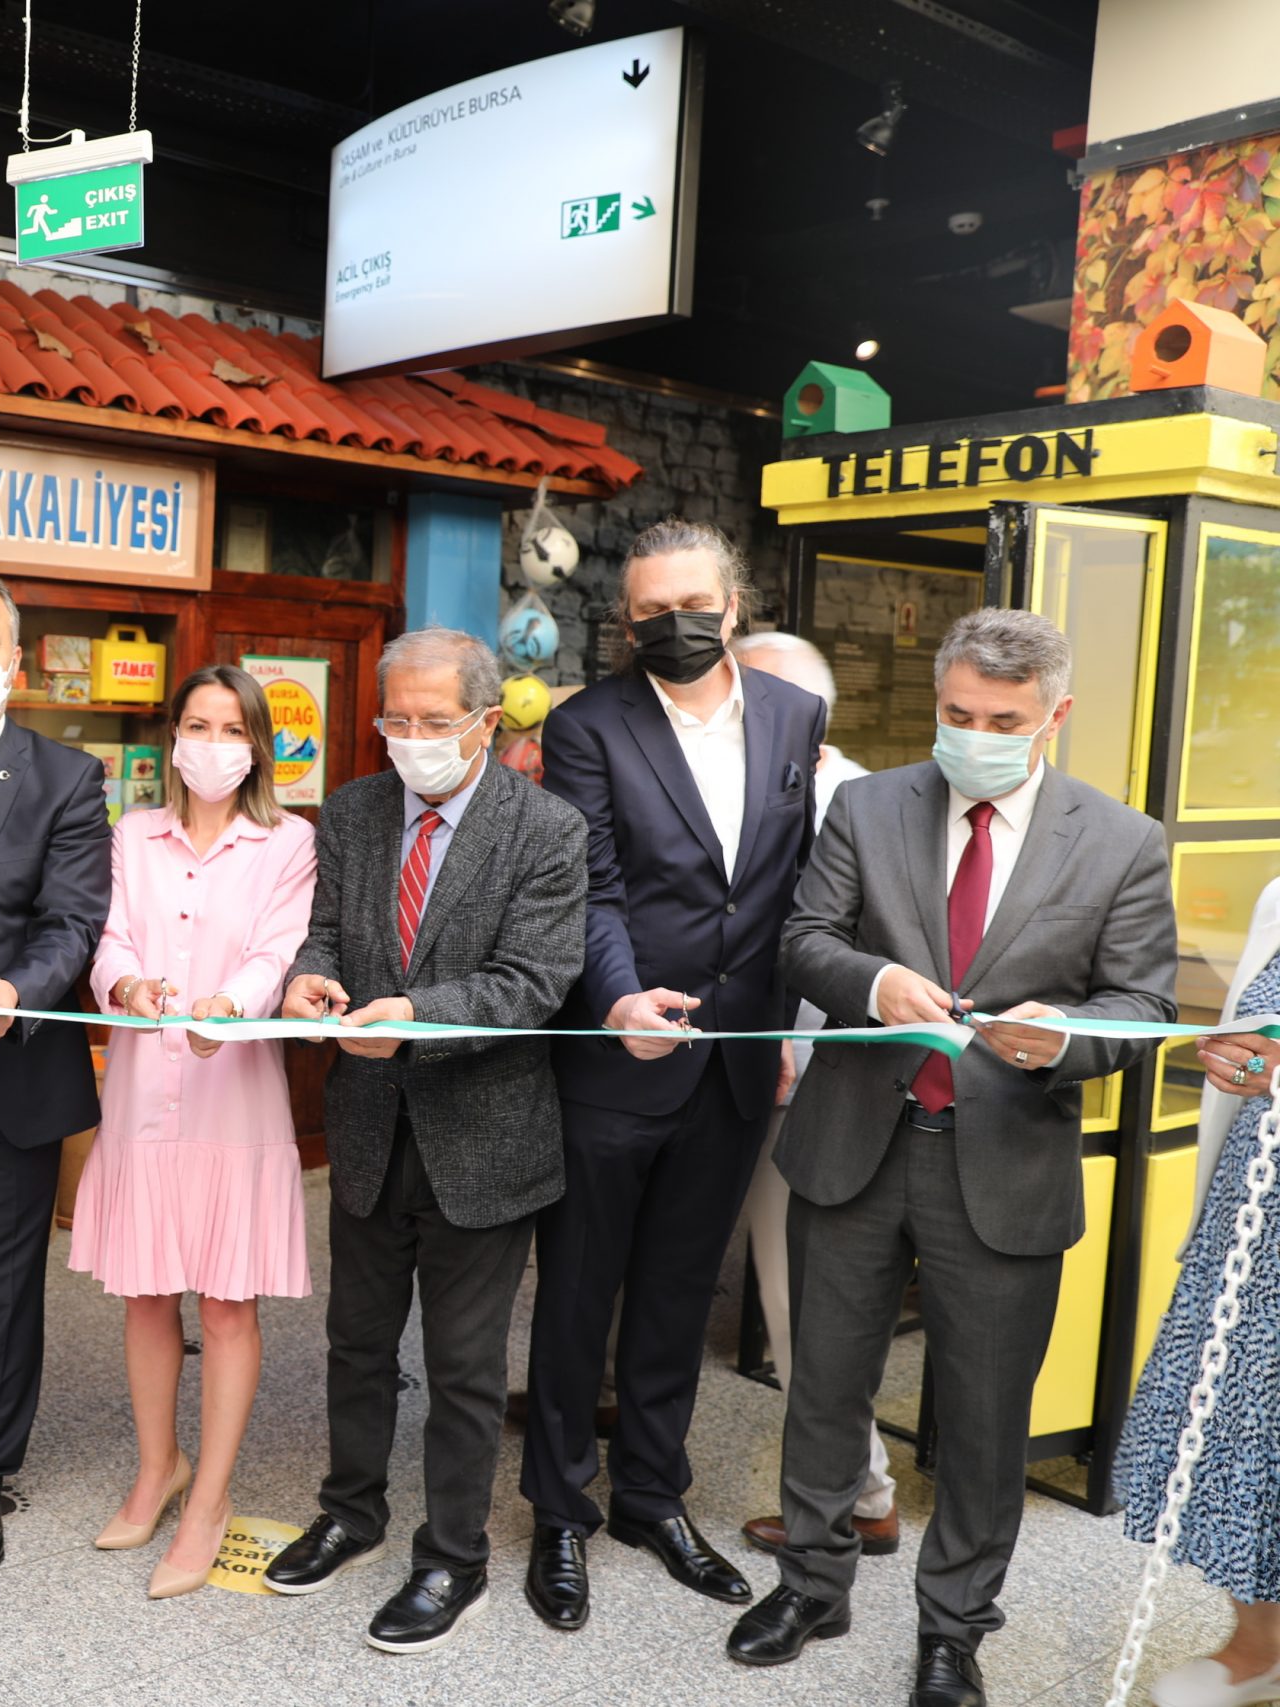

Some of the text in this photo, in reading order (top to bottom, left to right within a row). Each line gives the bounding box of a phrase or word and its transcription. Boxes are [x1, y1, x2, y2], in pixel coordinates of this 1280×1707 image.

[387, 102, 466, 145] KÜLTÜRÜYLE
[468, 85, 523, 116] BURSA
[84, 184, 137, 208] ÇIKIŞ
[85, 210, 129, 230] EXIT
[361, 250, 392, 279] ÇIKIŞ
[822, 428, 1095, 499] TELEFON
